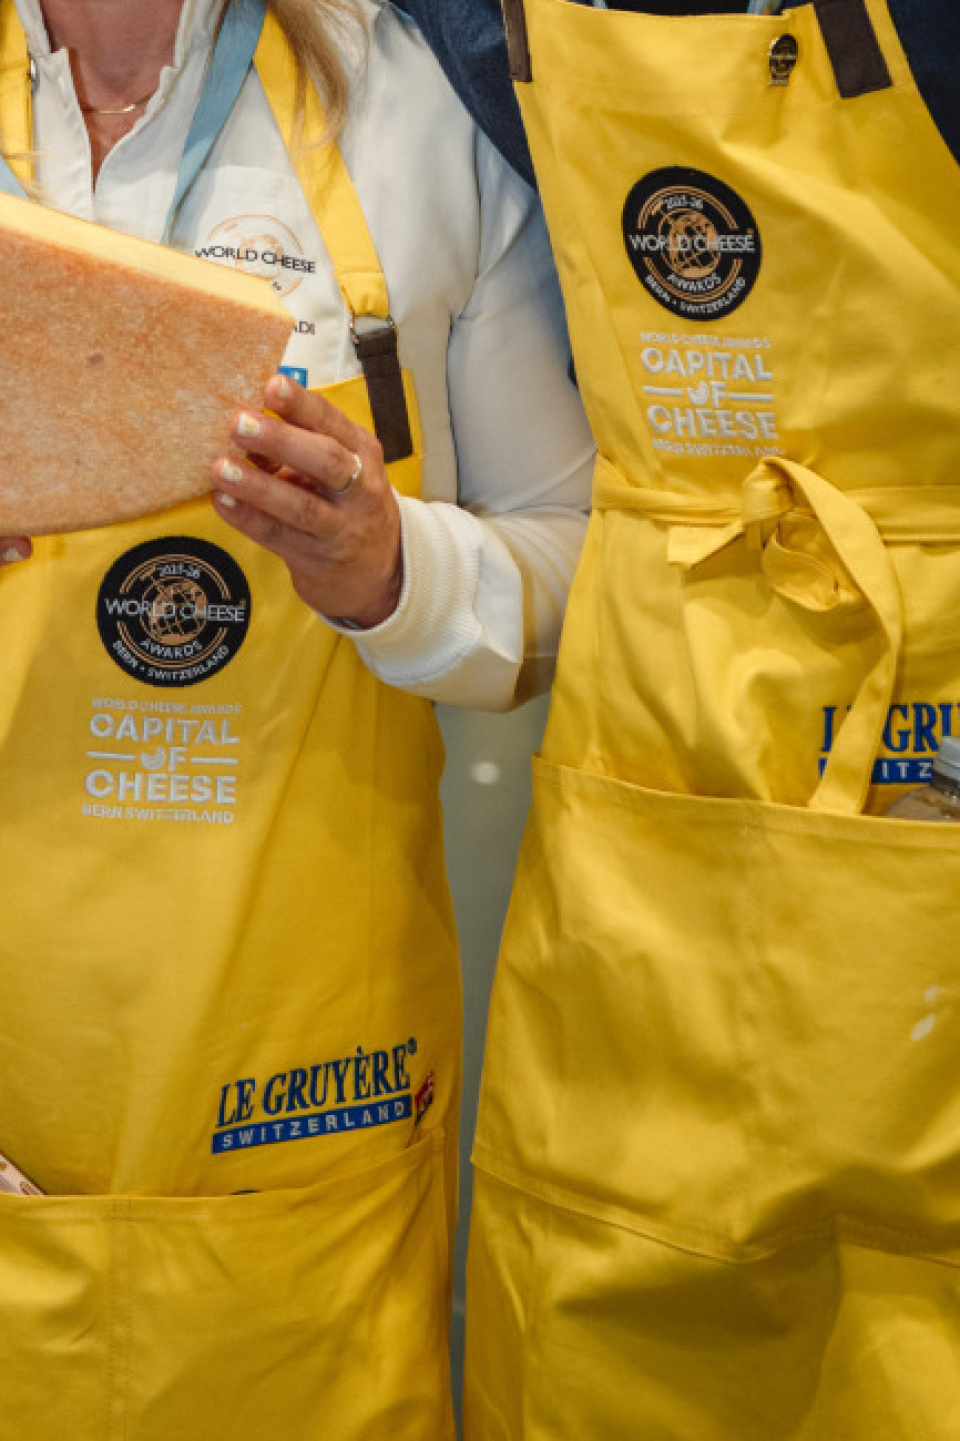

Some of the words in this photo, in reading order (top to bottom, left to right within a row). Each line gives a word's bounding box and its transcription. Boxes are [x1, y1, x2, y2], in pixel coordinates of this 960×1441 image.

[629, 234, 690, 251] WORLD
[693, 234, 755, 253] CHEESE
[195, 246, 257, 262] WORLD
[261, 251, 316, 274] CHEESE
[667, 272, 721, 291] AWARDS
[641, 347, 773, 382] CAPITAL
[687, 381, 726, 409] OF
[647, 404, 779, 440] CHEESE
[104, 598, 176, 618] WORLD
[179, 604, 246, 623] CHEESE
[142, 638, 202, 659] AWARDS
[147, 645, 229, 681] SWITZERLAND
[91, 697, 138, 711] WORLD
[141, 700, 187, 714] CHEESE
[89, 713, 240, 744] CAPITAL
[141, 745, 187, 772] OF
[86, 768, 236, 805] CHEESE
[82, 802, 122, 819] BERN
[126, 806, 234, 825] SWITZERLAND
[215, 1077, 256, 1128] LE
[221, 1100, 406, 1149] SWITZERLAND
